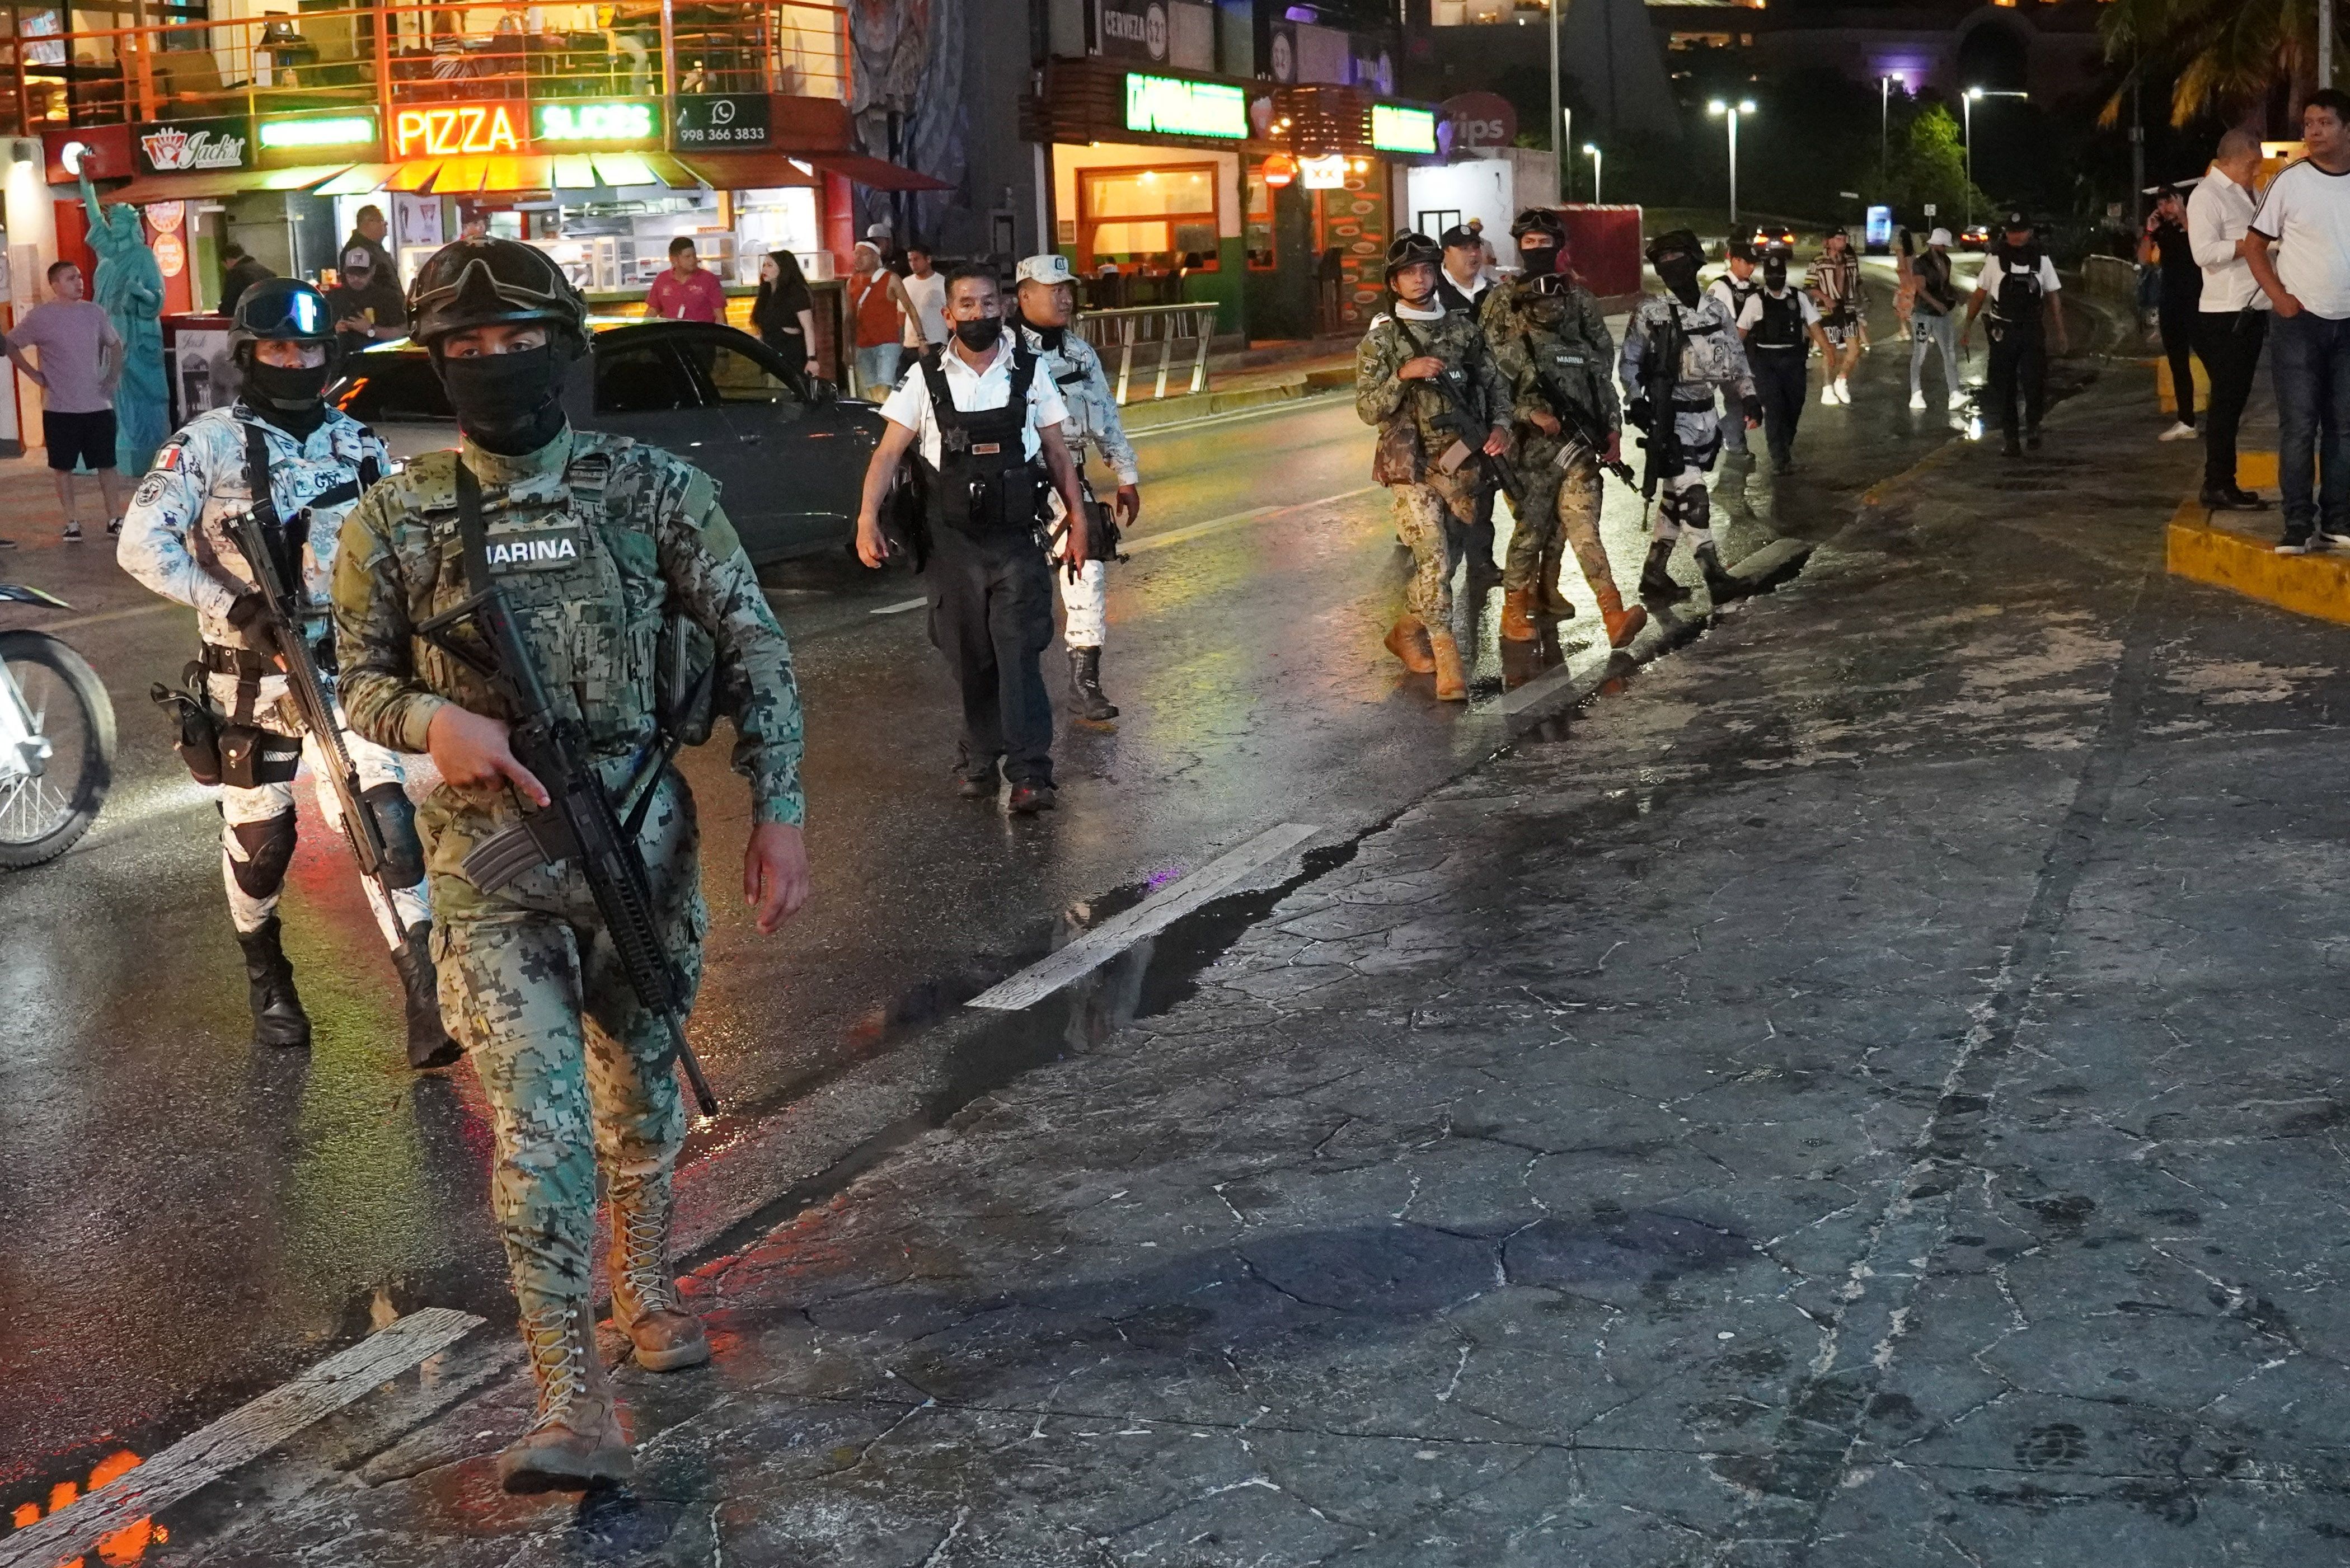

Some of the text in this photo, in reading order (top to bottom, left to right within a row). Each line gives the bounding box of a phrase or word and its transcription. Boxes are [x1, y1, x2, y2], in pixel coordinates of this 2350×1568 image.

[1104, 10, 1145, 42] CERVEZA
[398, 106, 517, 156] PIZZA
[681, 127, 764, 141] 998 366 3833
[177, 131, 245, 169] Jack's
[1556, 356, 1584, 364] MARINA
